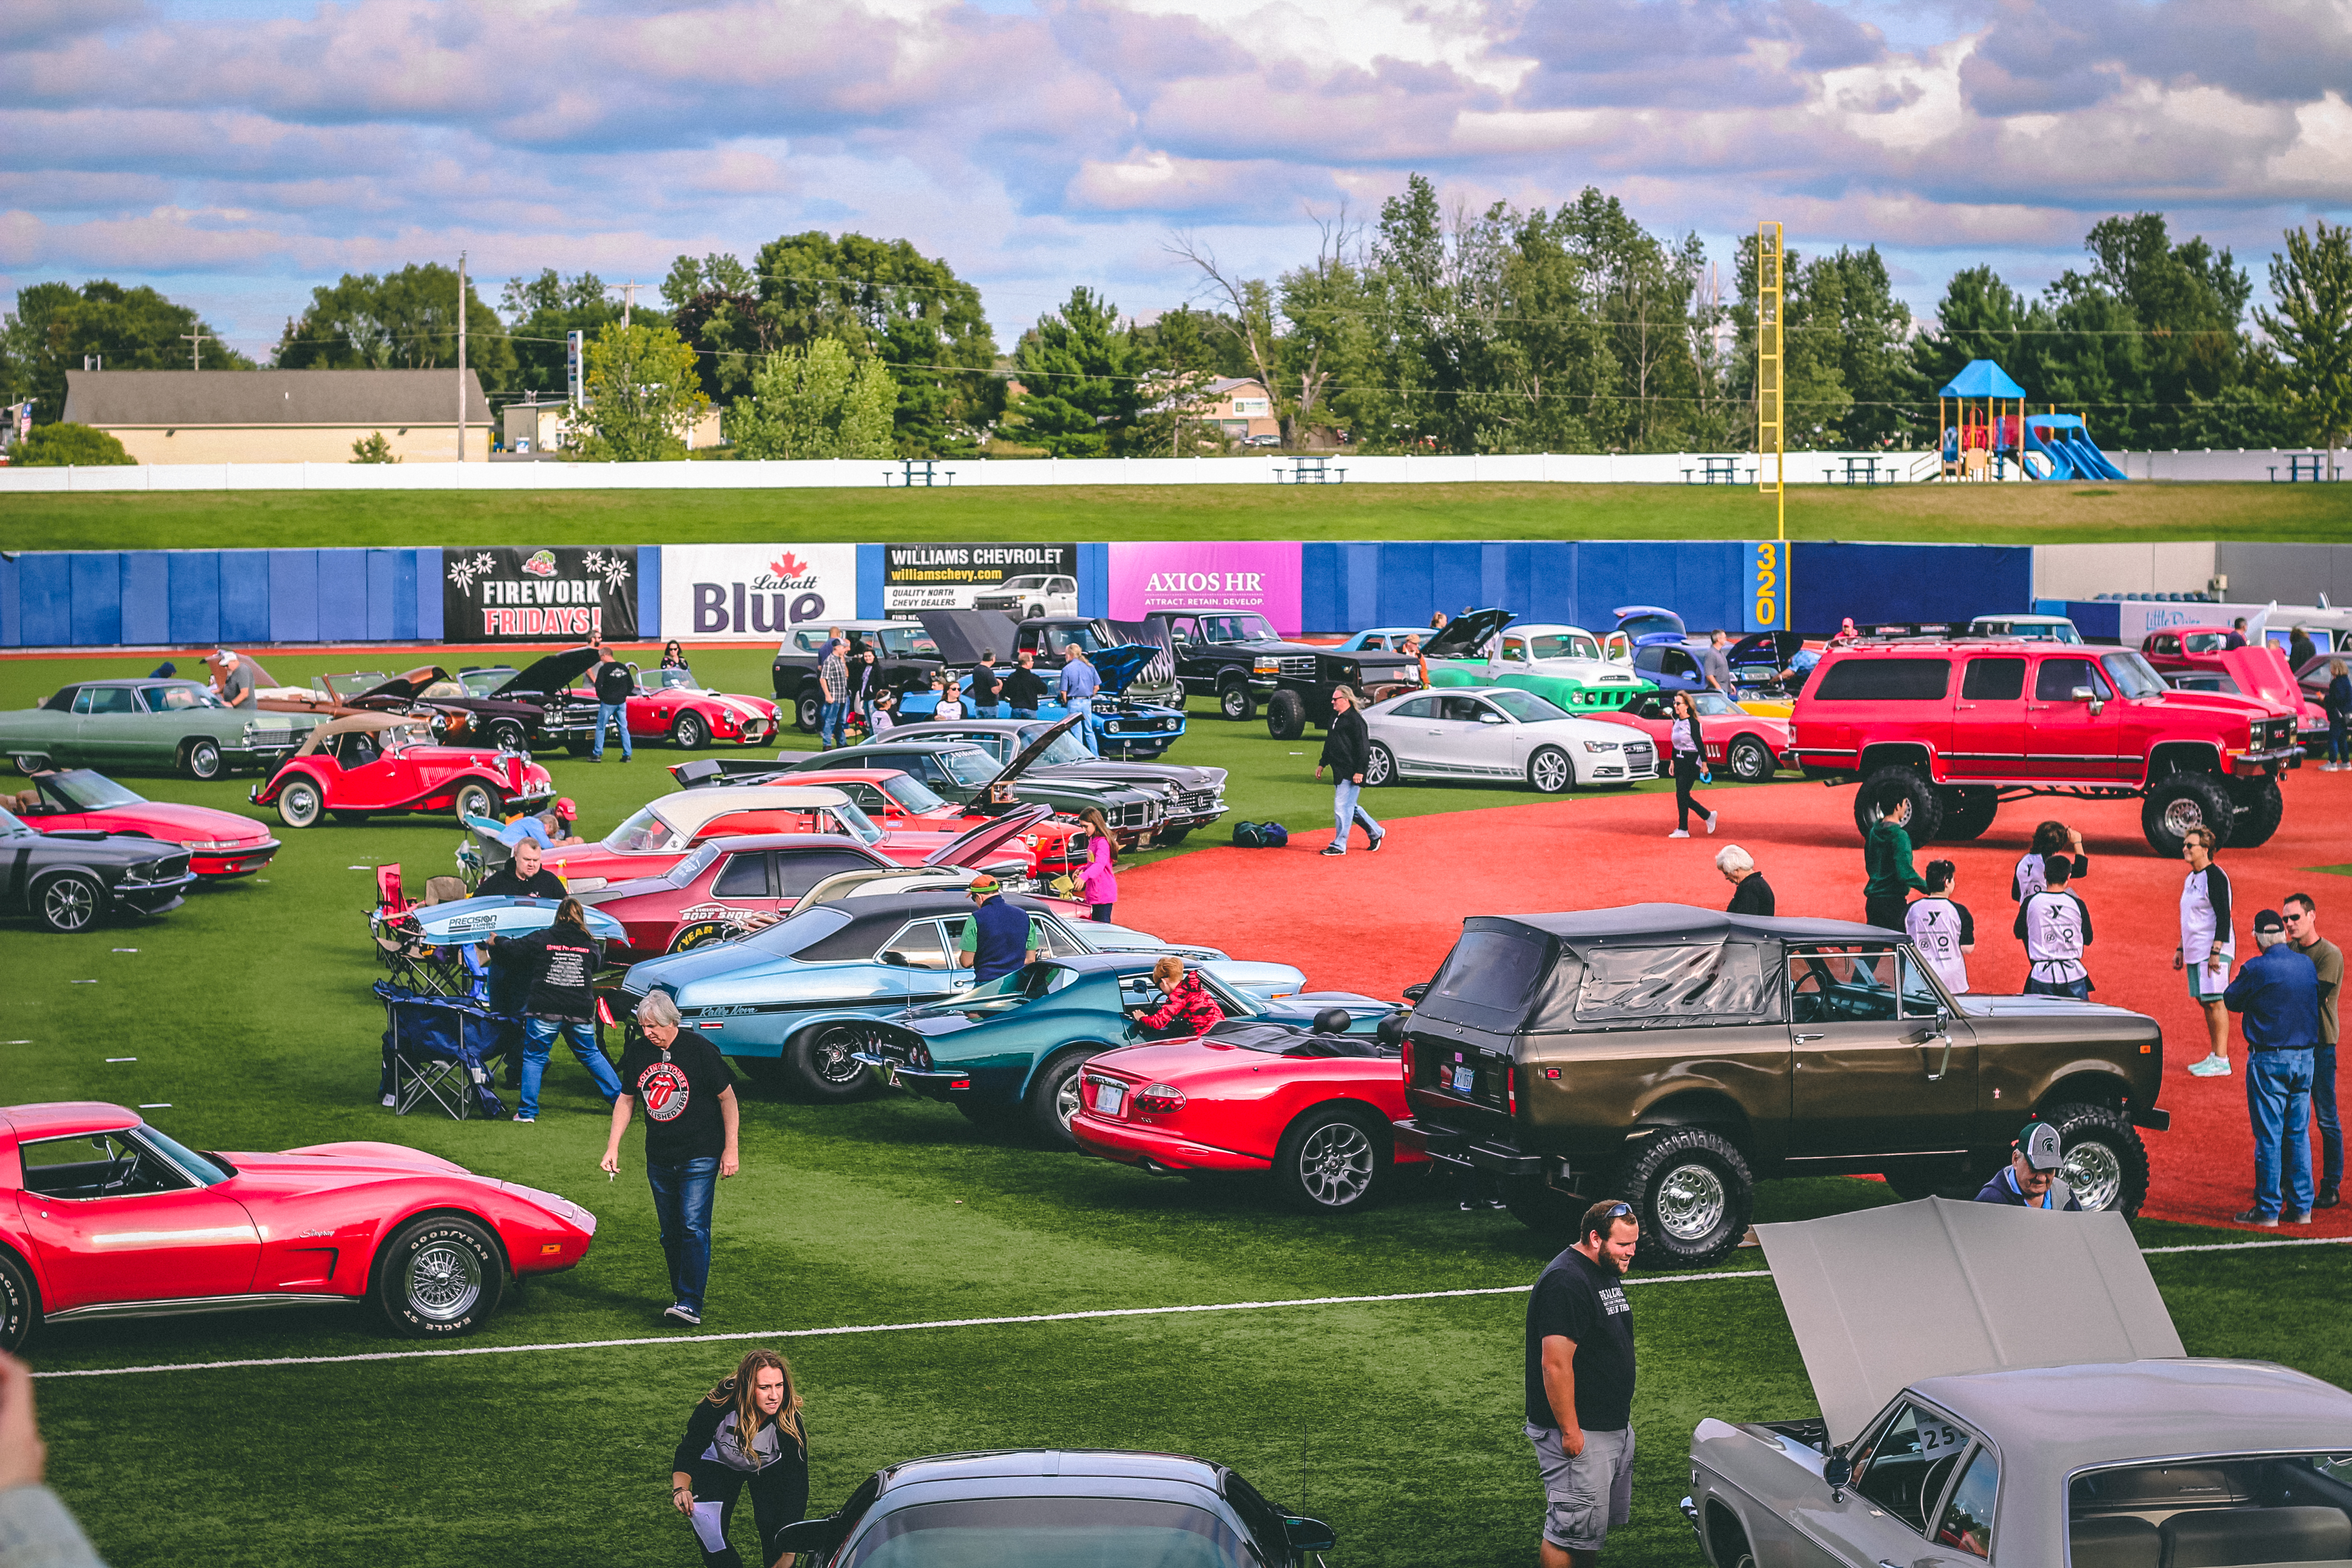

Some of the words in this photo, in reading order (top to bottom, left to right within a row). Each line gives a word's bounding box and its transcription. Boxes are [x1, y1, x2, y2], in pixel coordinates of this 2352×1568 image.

[891, 549, 969, 565] WILLIAMS
[973, 548, 1063, 564] CHEVROLET
[750, 574, 818, 590] Labatt
[891, 568, 1002, 583] williamschevy.com
[1145, 573, 1220, 592] AXIOS
[1225, 573, 1263, 592] HR
[1756, 543, 1777, 625] 320
[482, 580, 601, 604] FIREWORK
[892, 589, 926, 597] QUALITY
[928, 588, 954, 597] NORTH
[692, 582, 825, 633] Blue
[921, 598, 956, 607] DEALERS
[481, 606, 602, 636] FRIDAYS!
[449, 915, 497, 926] PRECISION
[681, 912, 715, 921] BODY
[717, 911, 754, 920] SHOP
[699, 1006, 729, 1018] Rally
[730, 1005, 758, 1015] Nova
[666, 1065, 687, 1088] TONES
[676, 1092, 687, 1111] 1962
[299, 1228, 335, 1239] Stingray
[411, 1230, 489, 1260] GOODYEAR
[8, 1315, 18, 1334] ST
[403, 1310, 419, 1323] ST
[425, 1317, 471, 1331] EAGLE
[1924, 1425, 1955, 1450] 25
